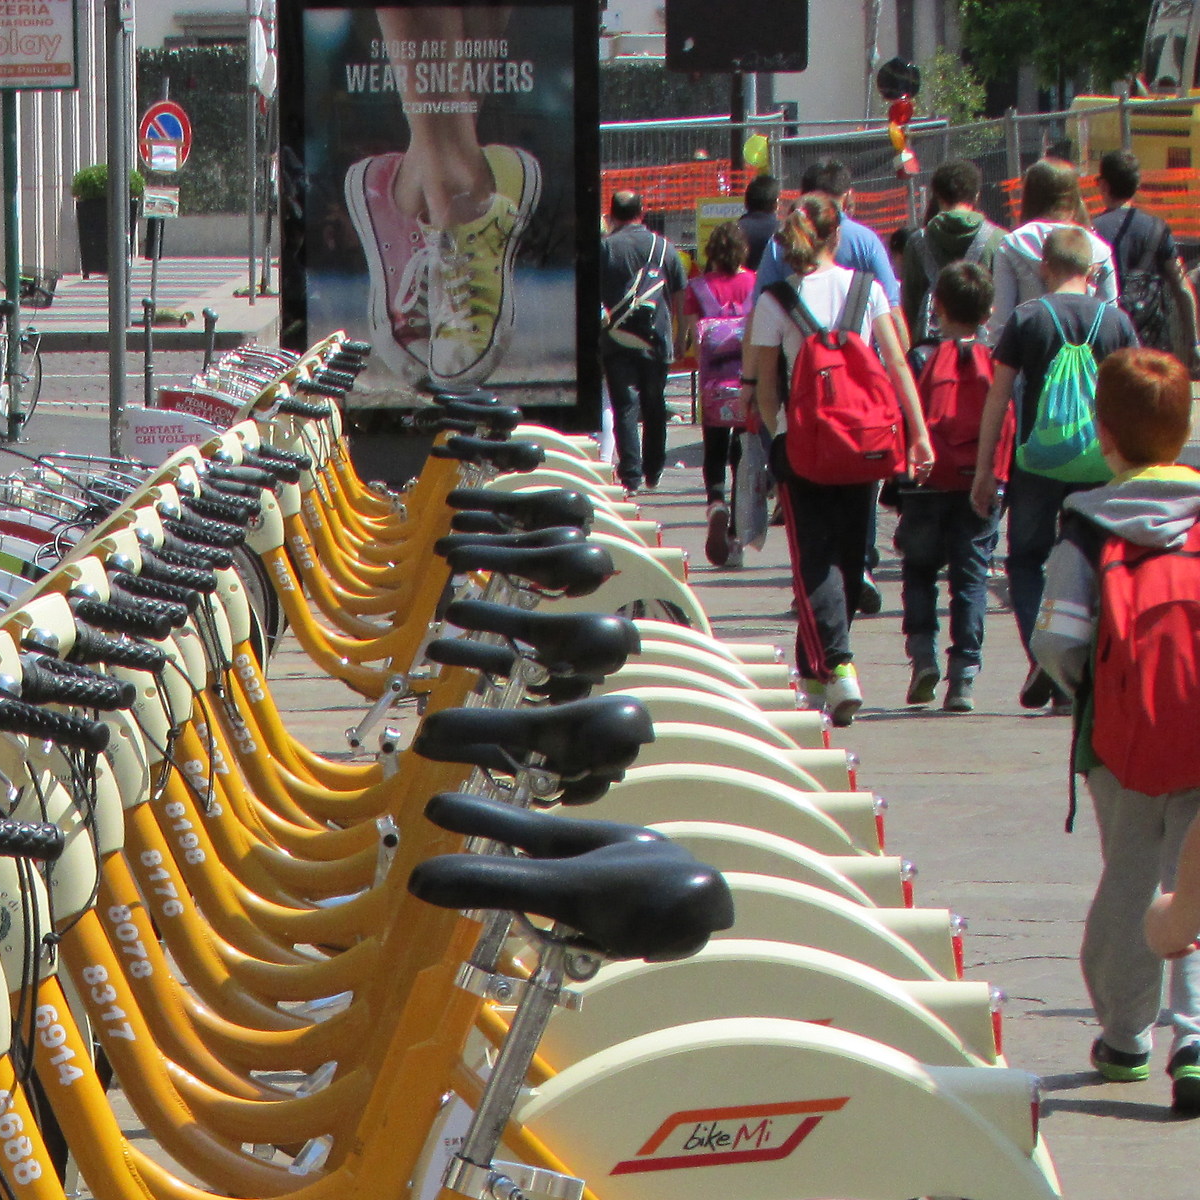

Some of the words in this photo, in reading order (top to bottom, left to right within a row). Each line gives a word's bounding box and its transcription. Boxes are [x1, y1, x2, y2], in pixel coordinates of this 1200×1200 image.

[371, 39, 417, 59] SHOES
[421, 39, 447, 59] ARE
[455, 39, 508, 58] BORING
[345, 63, 409, 94] WEAR
[415, 61, 534, 94] SNEAKERS
[401, 100, 478, 114] CONVERSE
[135, 425, 184, 434] PORTATE
[136, 435, 156, 444] CHI
[165, 801, 206, 865] 8198
[140, 849, 184, 917] 8176
[108, 904, 153, 979] 8078
[82, 964, 136, 1042] 8317
[35, 1004, 84, 1086] 6914
